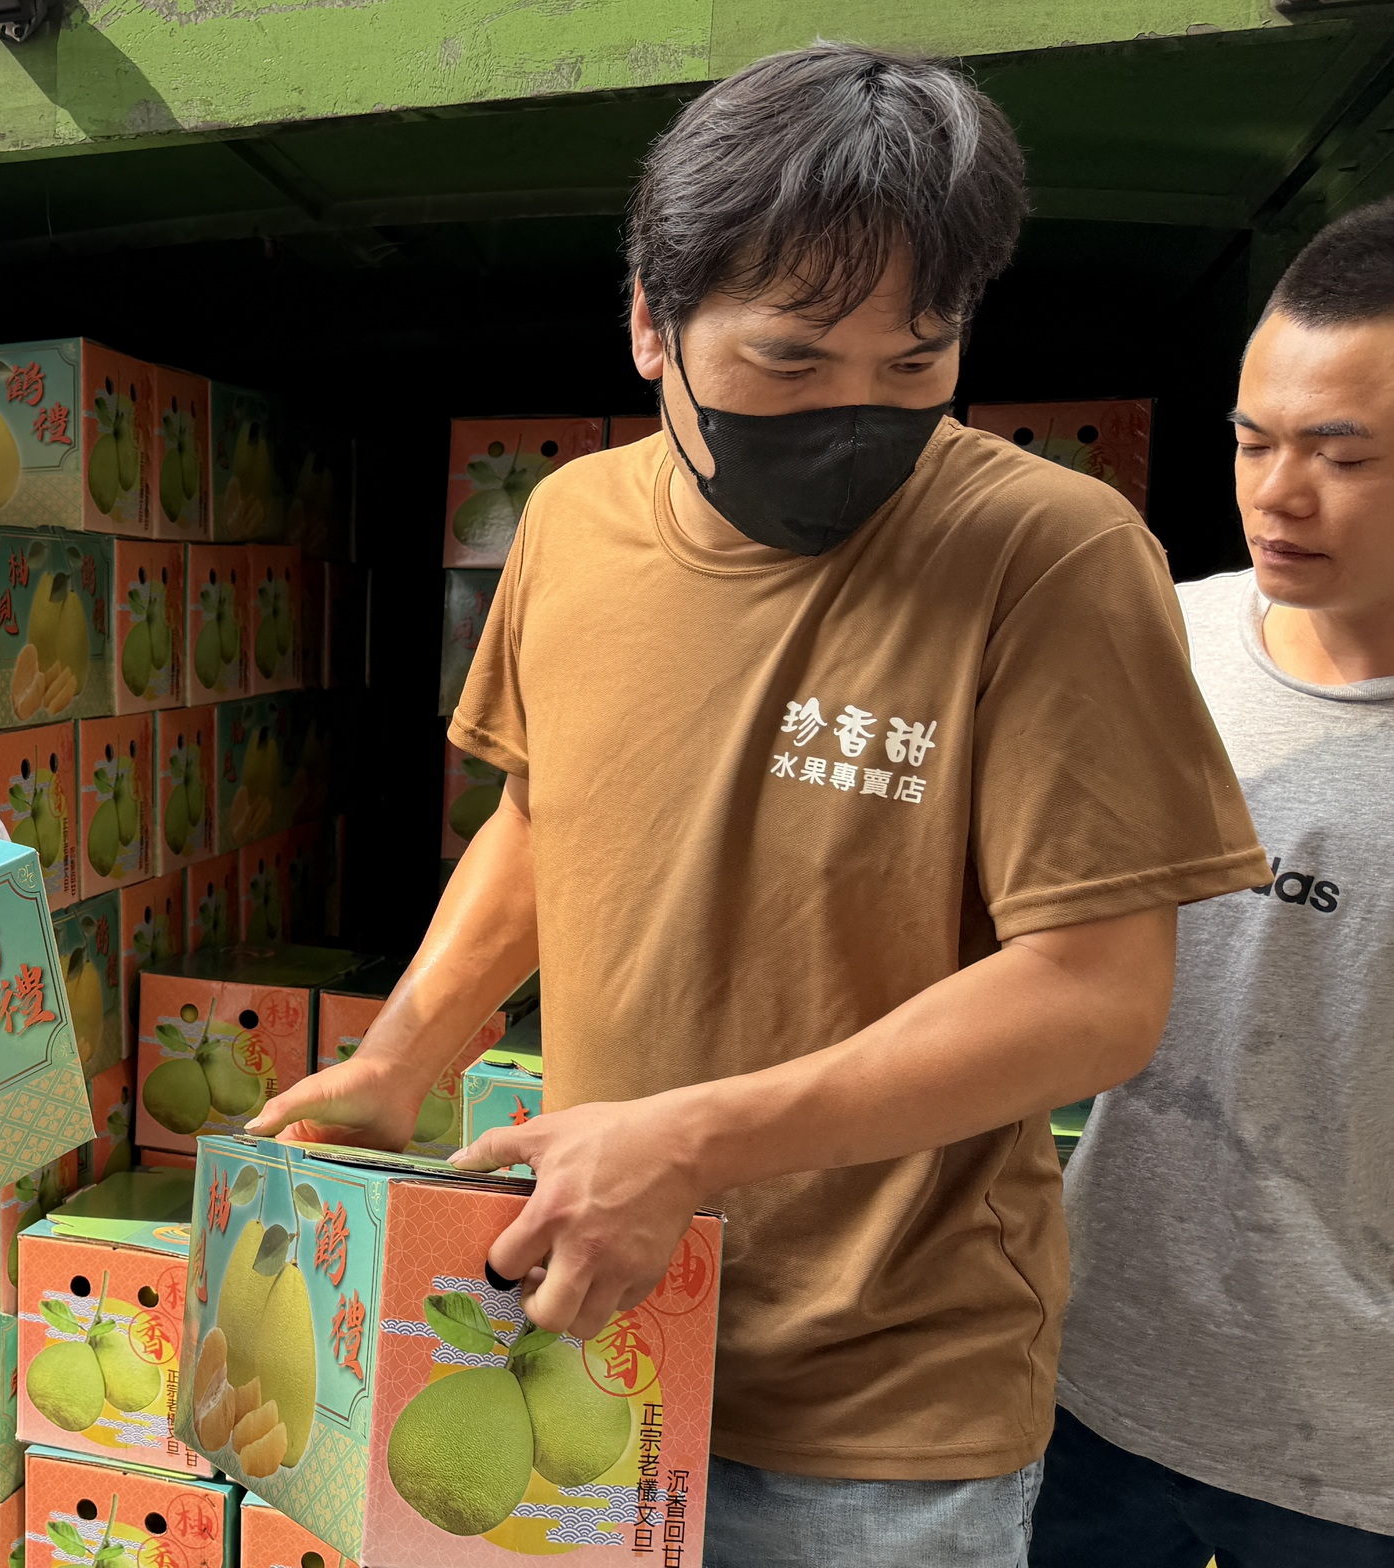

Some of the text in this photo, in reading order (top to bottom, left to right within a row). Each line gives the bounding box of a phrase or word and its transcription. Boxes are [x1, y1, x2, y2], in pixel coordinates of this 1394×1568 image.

[780, 697, 938, 767] 珍香甜
[770, 752, 927, 804] 水果專賣店
[661, 1468, 690, 1568] 沉香回甘
